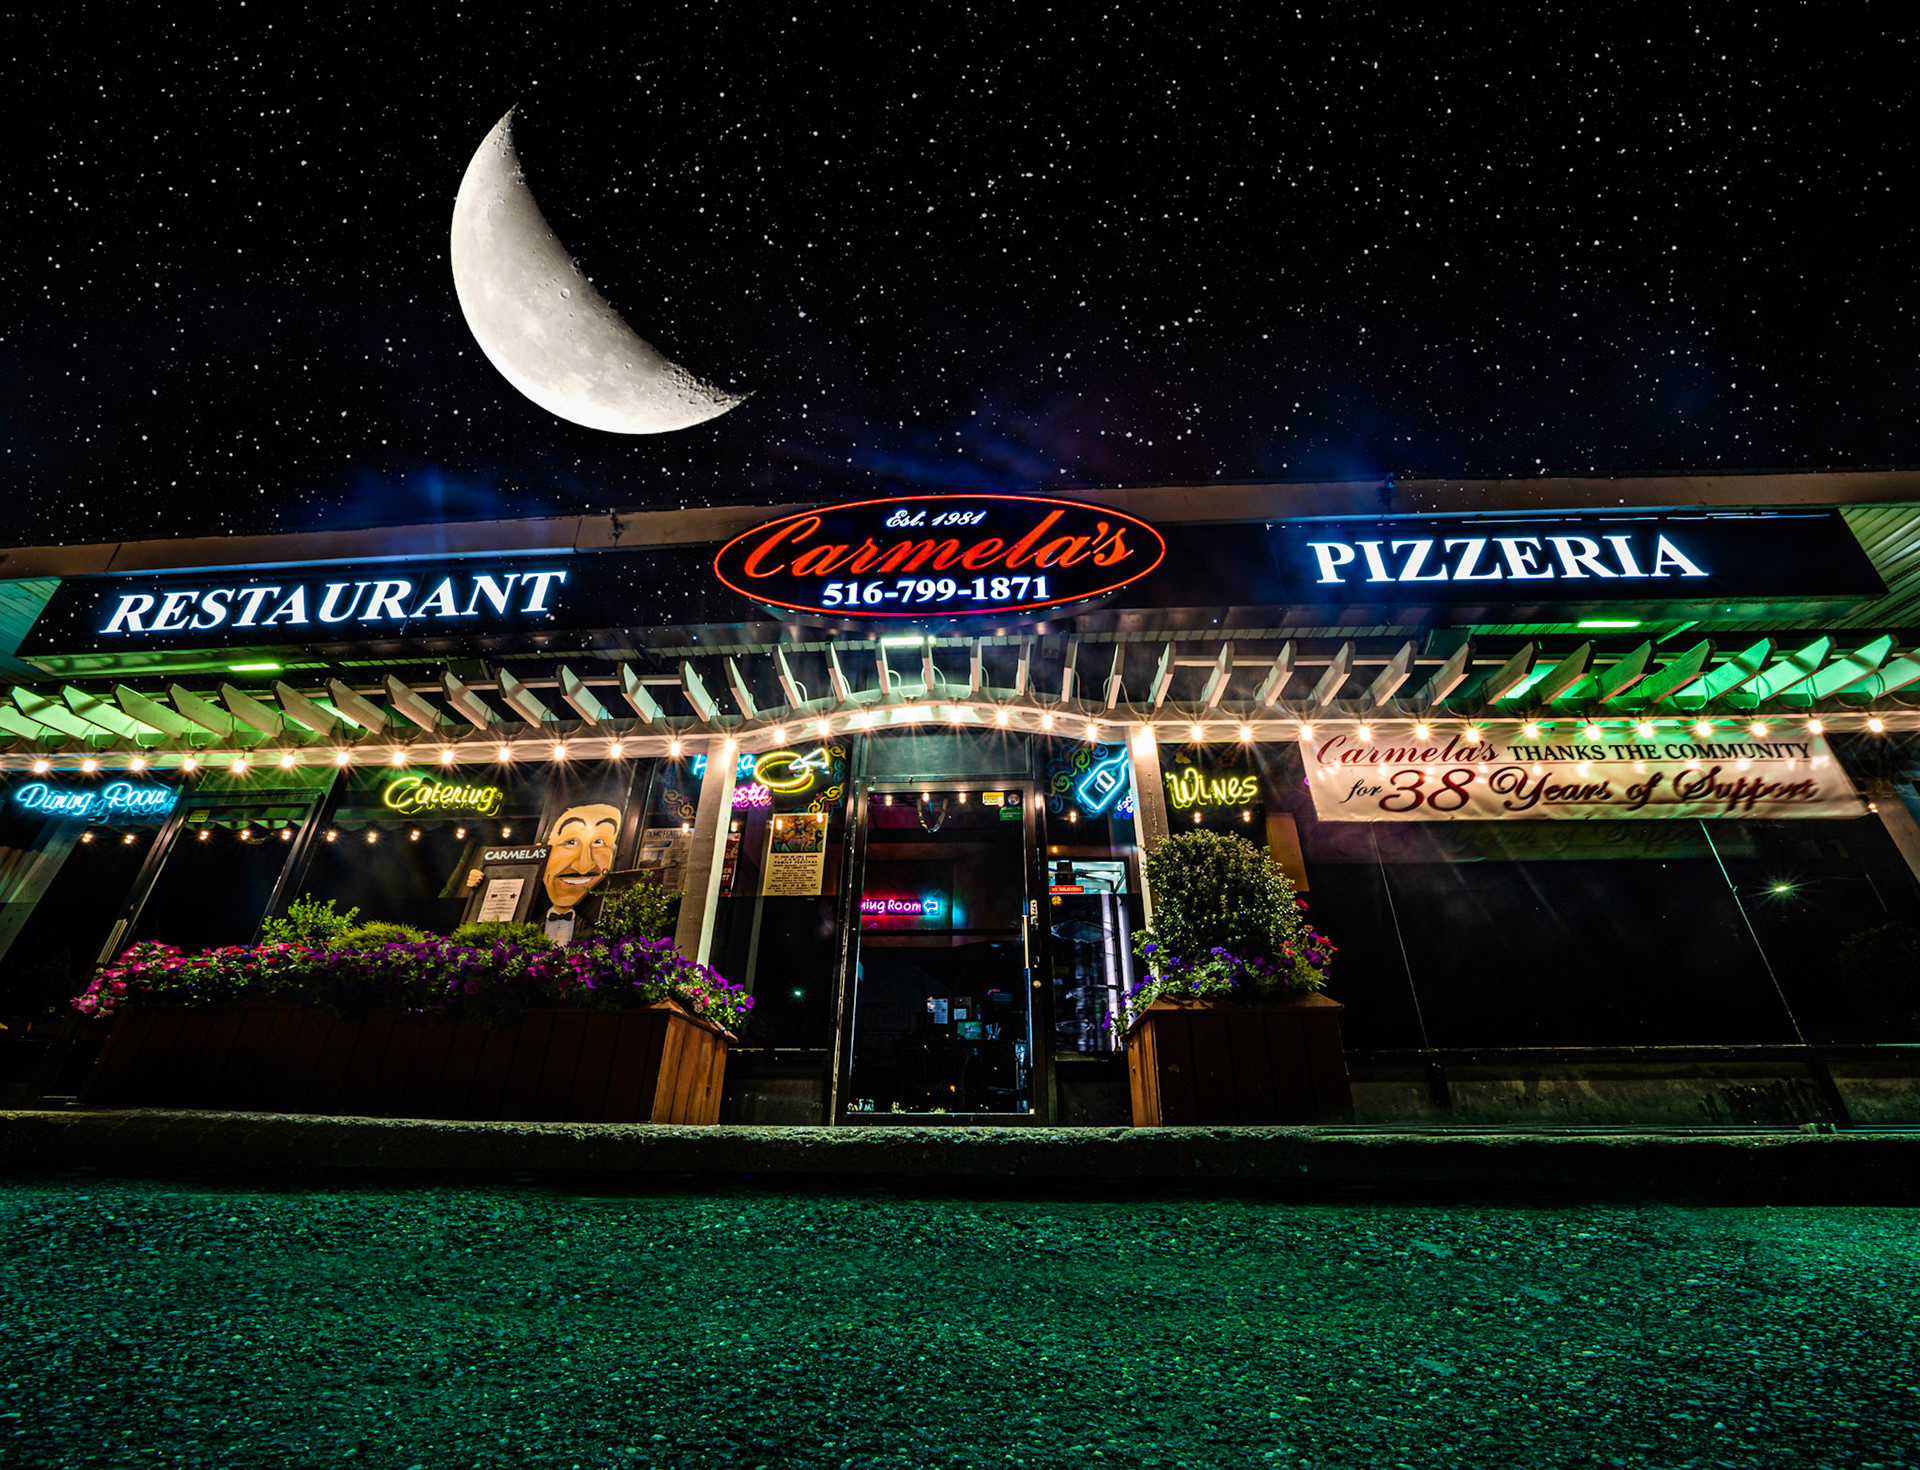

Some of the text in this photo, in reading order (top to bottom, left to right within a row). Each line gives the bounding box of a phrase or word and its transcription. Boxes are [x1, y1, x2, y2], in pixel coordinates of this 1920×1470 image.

[885, 509, 988, 528] Est. 1981
[743, 510, 1134, 578] Carmela's
[1306, 534, 1709, 584] PIZZERIA
[99, 571, 567, 634] RESTAURANT
[822, 575, 1050, 606] 516-799-1871
[1316, 734, 1810, 764] Carmela's THANKS THE COMMUNITY
[17, 782, 169, 816] Dining Room
[384, 776, 499, 812] Catering
[1339, 765, 1820, 812] for 38 Years of Support
[484, 848, 547, 861] CARMELA'S
[887, 899, 922, 912] Room
